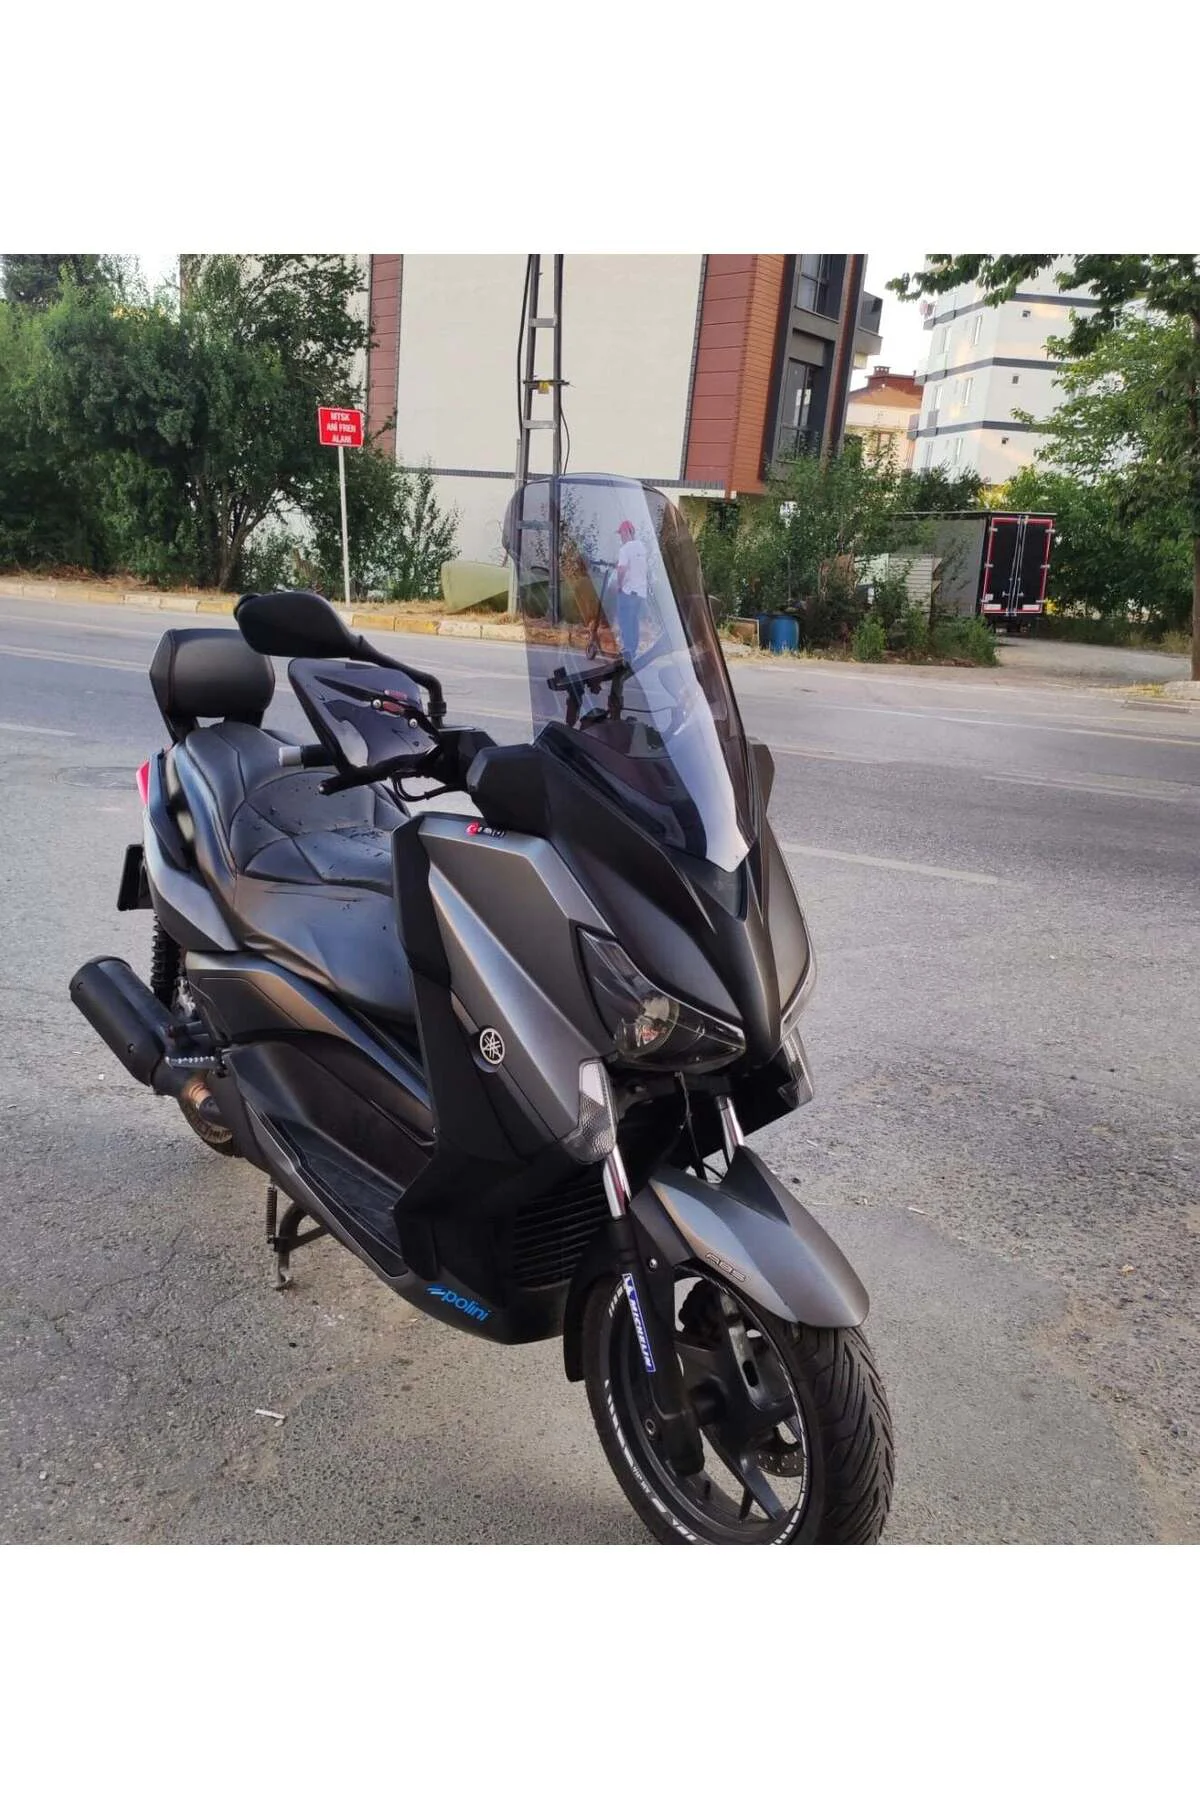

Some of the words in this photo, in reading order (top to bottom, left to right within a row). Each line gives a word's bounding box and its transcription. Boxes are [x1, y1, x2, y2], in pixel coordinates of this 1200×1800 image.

[705, 1252, 746, 1283] ABS
[441, 1290, 492, 1322] polini
[629, 1299, 653, 1368] MICHELIN
